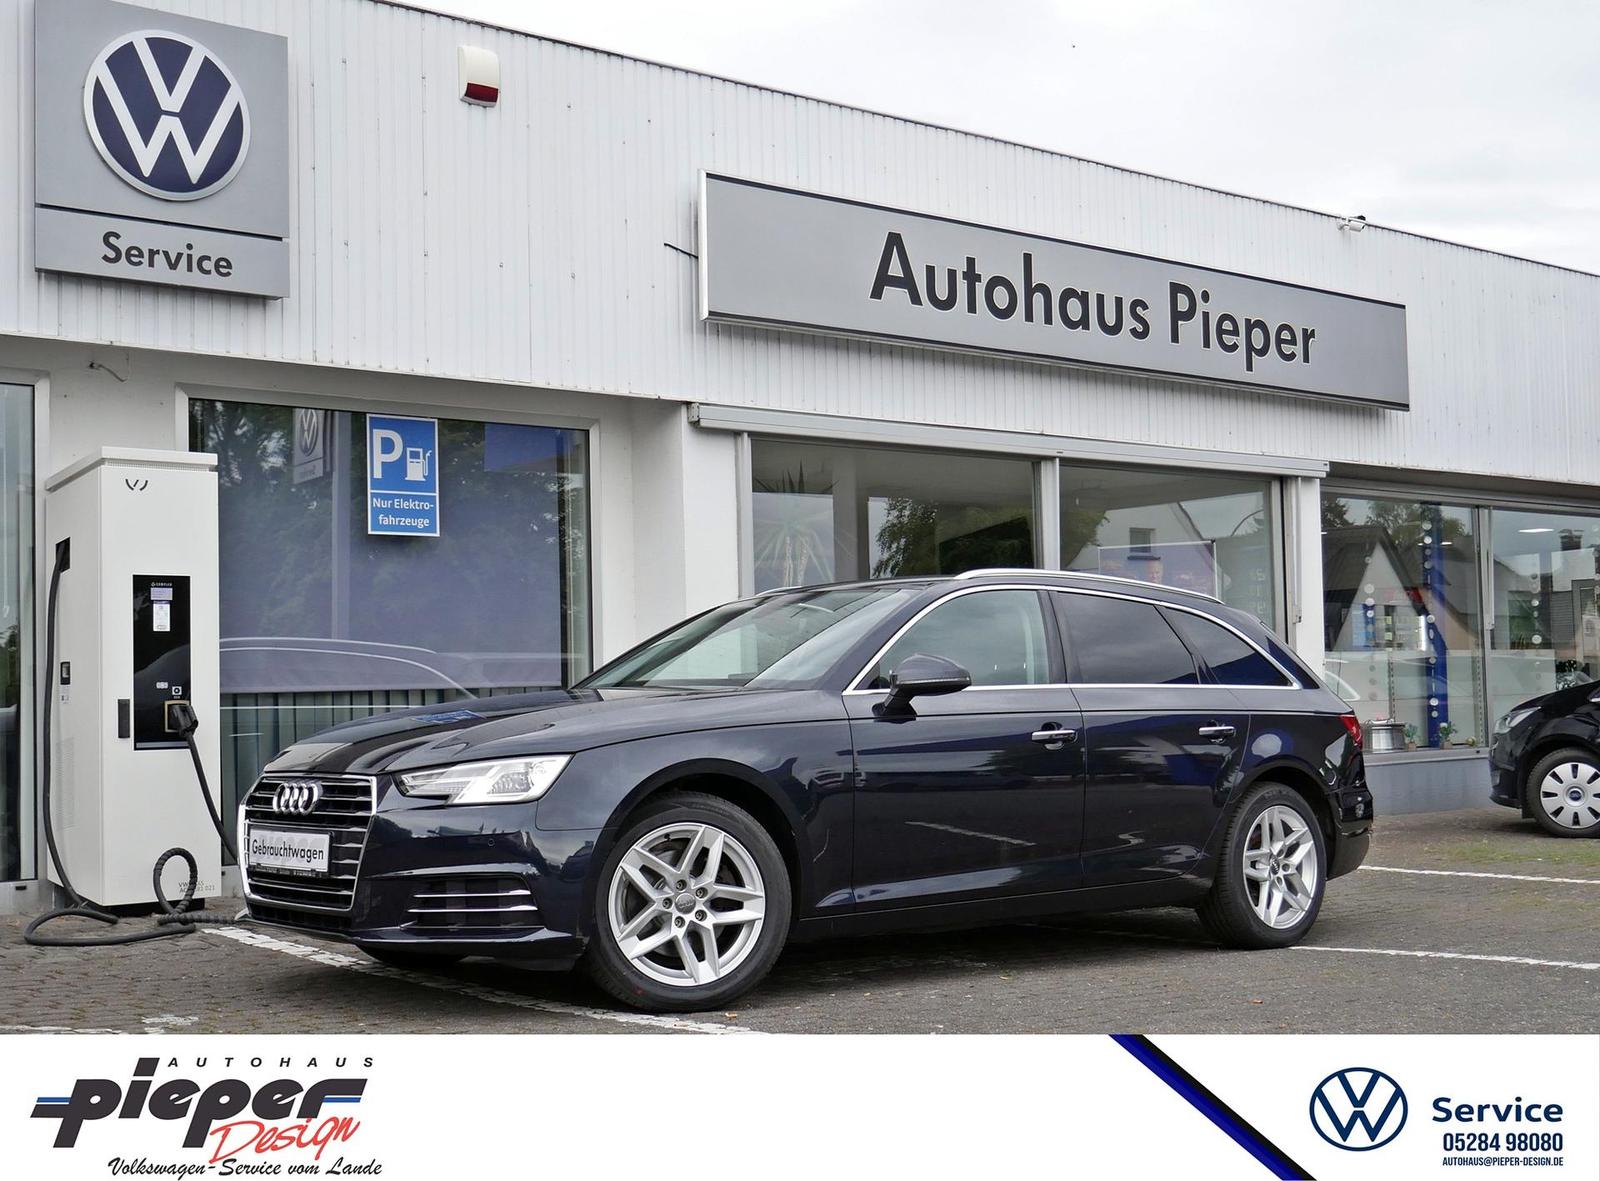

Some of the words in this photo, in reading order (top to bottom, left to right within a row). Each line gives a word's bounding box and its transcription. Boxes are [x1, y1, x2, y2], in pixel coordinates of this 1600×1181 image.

[101, 231, 233, 278] Service
[869, 231, 1151, 340] Autohaus
[1169, 281, 1316, 372] Pieper
[373, 429, 403, 479] P
[373, 497, 394, 508] Nur
[394, 498, 434, 510] Elektro-
[379, 513, 430, 528] fahrzeuge
[252, 839, 324, 863] Gebrauchtwagen
